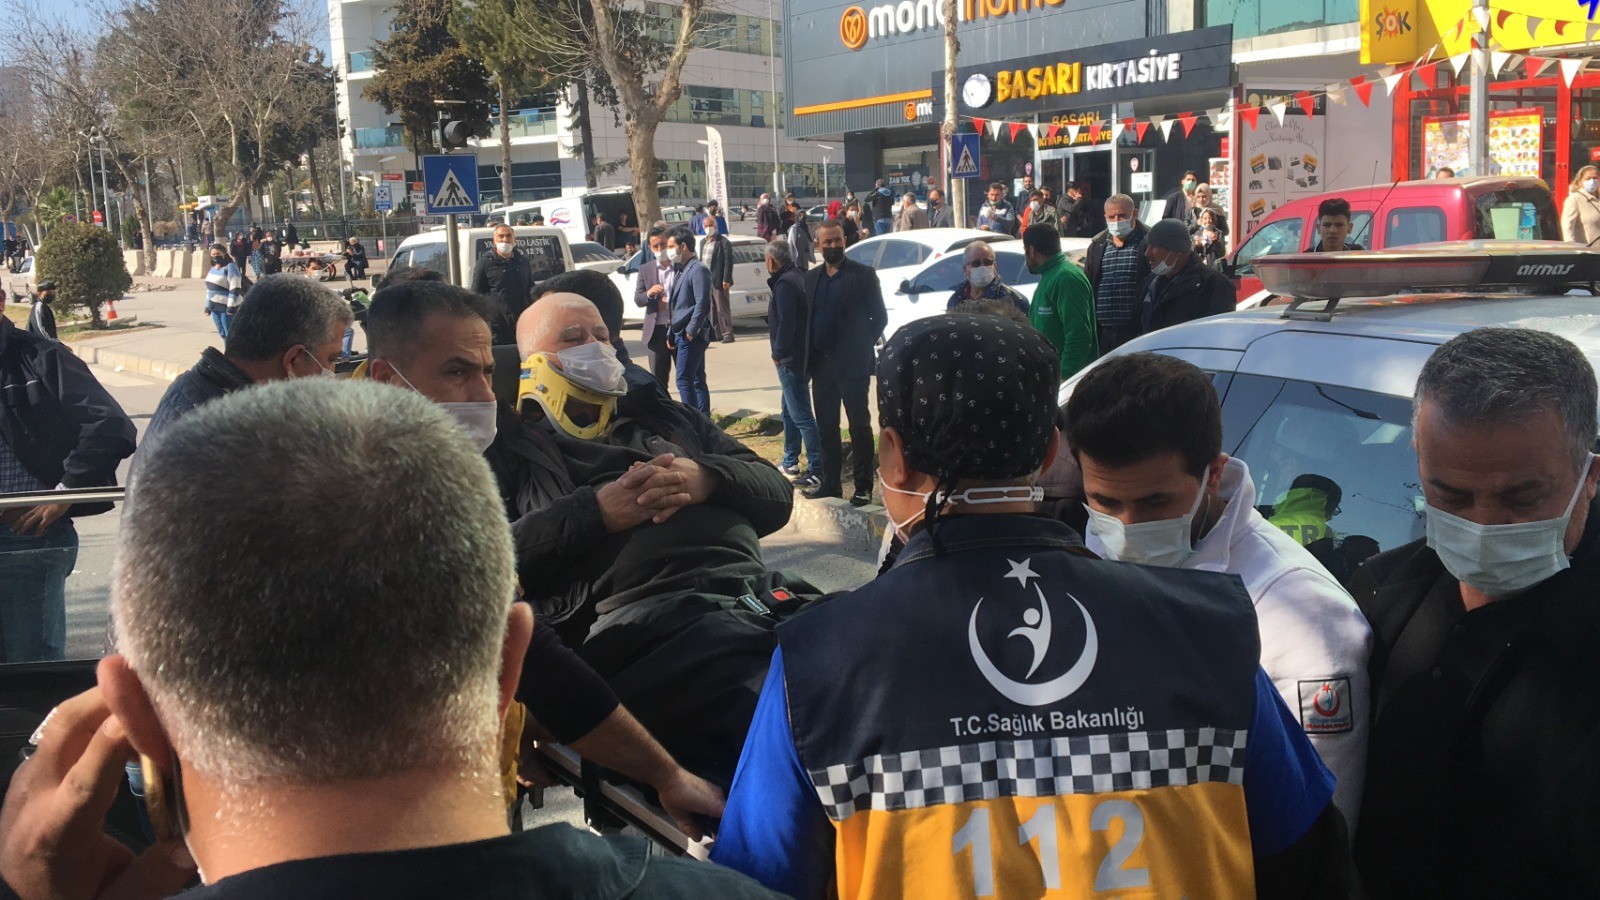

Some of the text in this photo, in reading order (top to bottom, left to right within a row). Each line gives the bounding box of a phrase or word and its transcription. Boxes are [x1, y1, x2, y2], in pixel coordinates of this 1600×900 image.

[1375, 10, 1412, 41] ŞOK
[997, 49, 1181, 102] BAŞARI KIRTASİYE
[526, 236, 551, 247] LASTİK
[1516, 264, 1575, 276] armas
[1050, 706, 1145, 731] Bakanlığı
[952, 799, 1150, 897] 112
